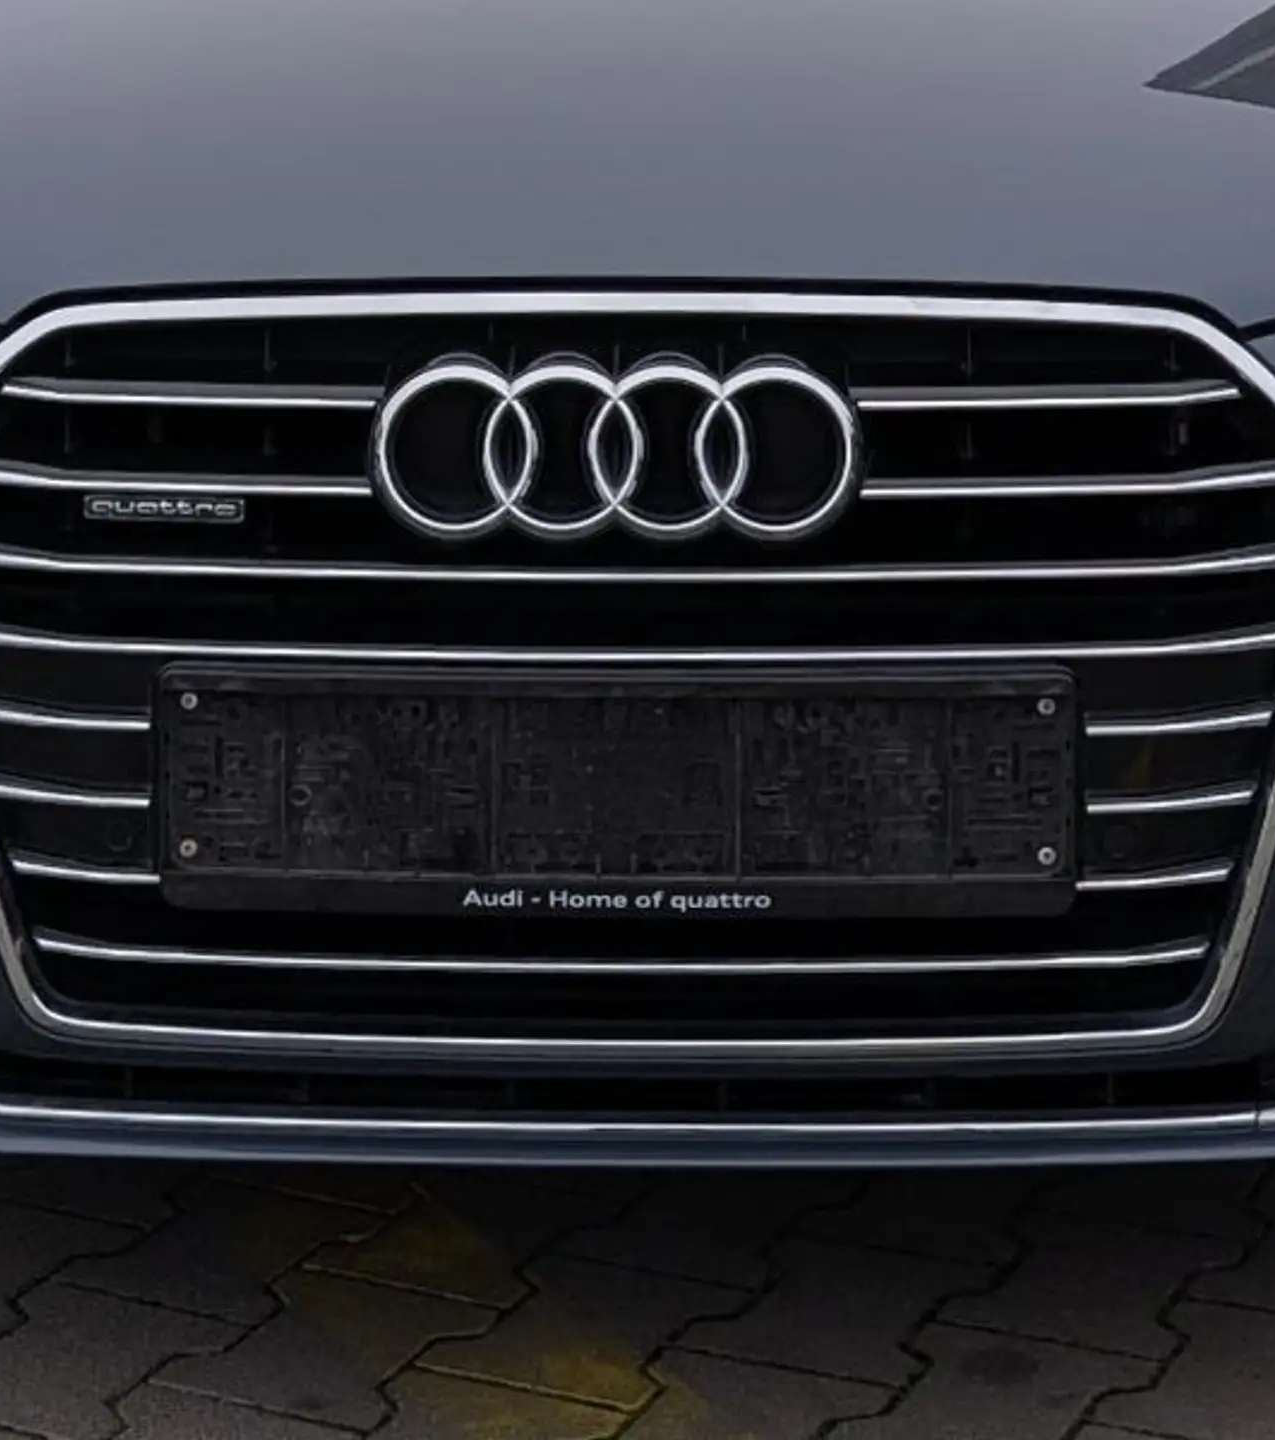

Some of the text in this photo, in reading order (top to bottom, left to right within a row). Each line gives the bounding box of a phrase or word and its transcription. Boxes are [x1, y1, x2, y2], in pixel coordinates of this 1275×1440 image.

[90, 499, 238, 517] quattro
[462, 888, 524, 908] Audi
[548, 890, 628, 909] Home
[634, 891, 665, 909] of
[670, 891, 772, 913] quattro
